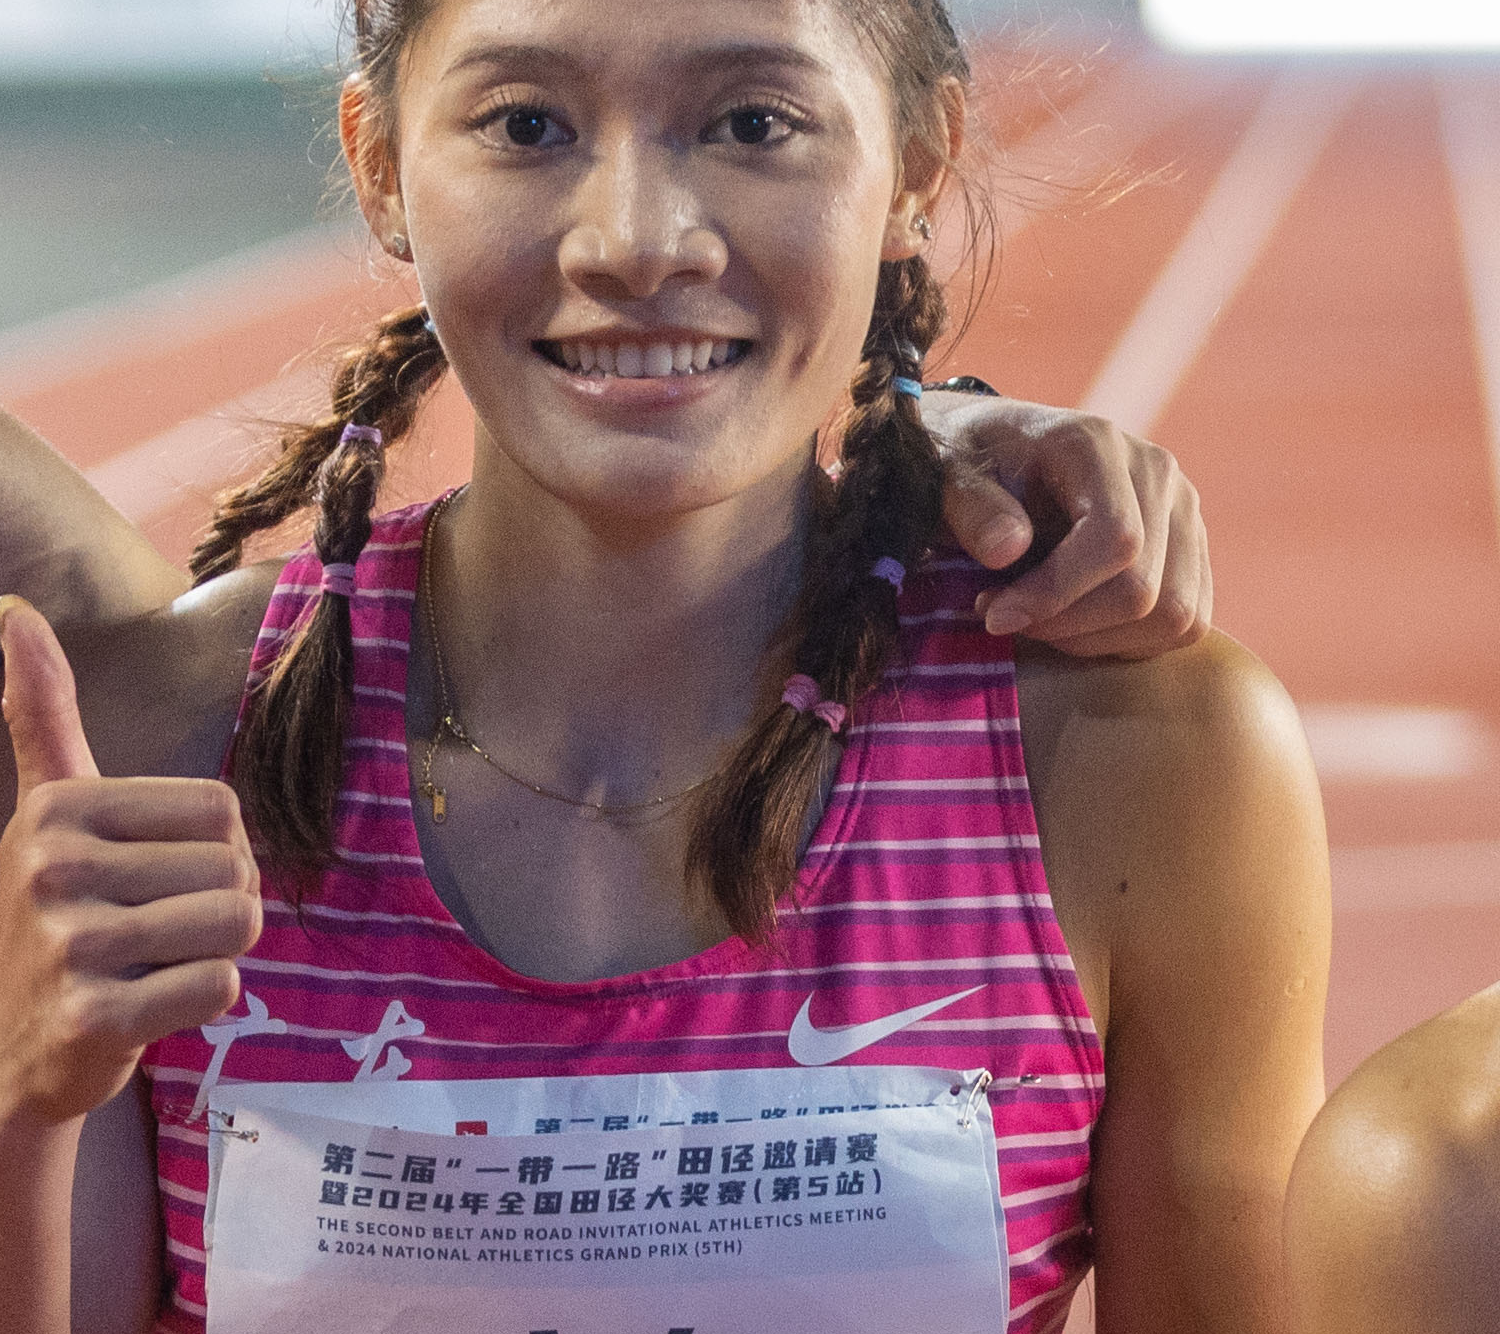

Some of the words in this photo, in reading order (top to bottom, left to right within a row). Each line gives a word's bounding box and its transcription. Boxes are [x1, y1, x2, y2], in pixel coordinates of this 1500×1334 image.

[317, 1217, 348, 1232] THE
[355, 1221, 425, 1239] SECOND
[433, 1227, 474, 1240] BELT
[480, 1228, 516, 1240] AND
[524, 1227, 572, 1240] ROAD
[579, 1221, 701, 1239] INVITATIONAL
[709, 1214, 802, 1232] ATHLETICS
[809, 1207, 886, 1225] MEETING
[318, 1239, 329, 1252] &
[336, 1242, 375, 1257] 2024
[382, 1245, 471, 1261] NATIONAL
[477, 1248, 573, 1262] ATHLETICS
[580, 1246, 641, 1261] GRAND
[648, 1243, 688, 1258] PRIX
[695, 1239, 742, 1258] (5TH)
